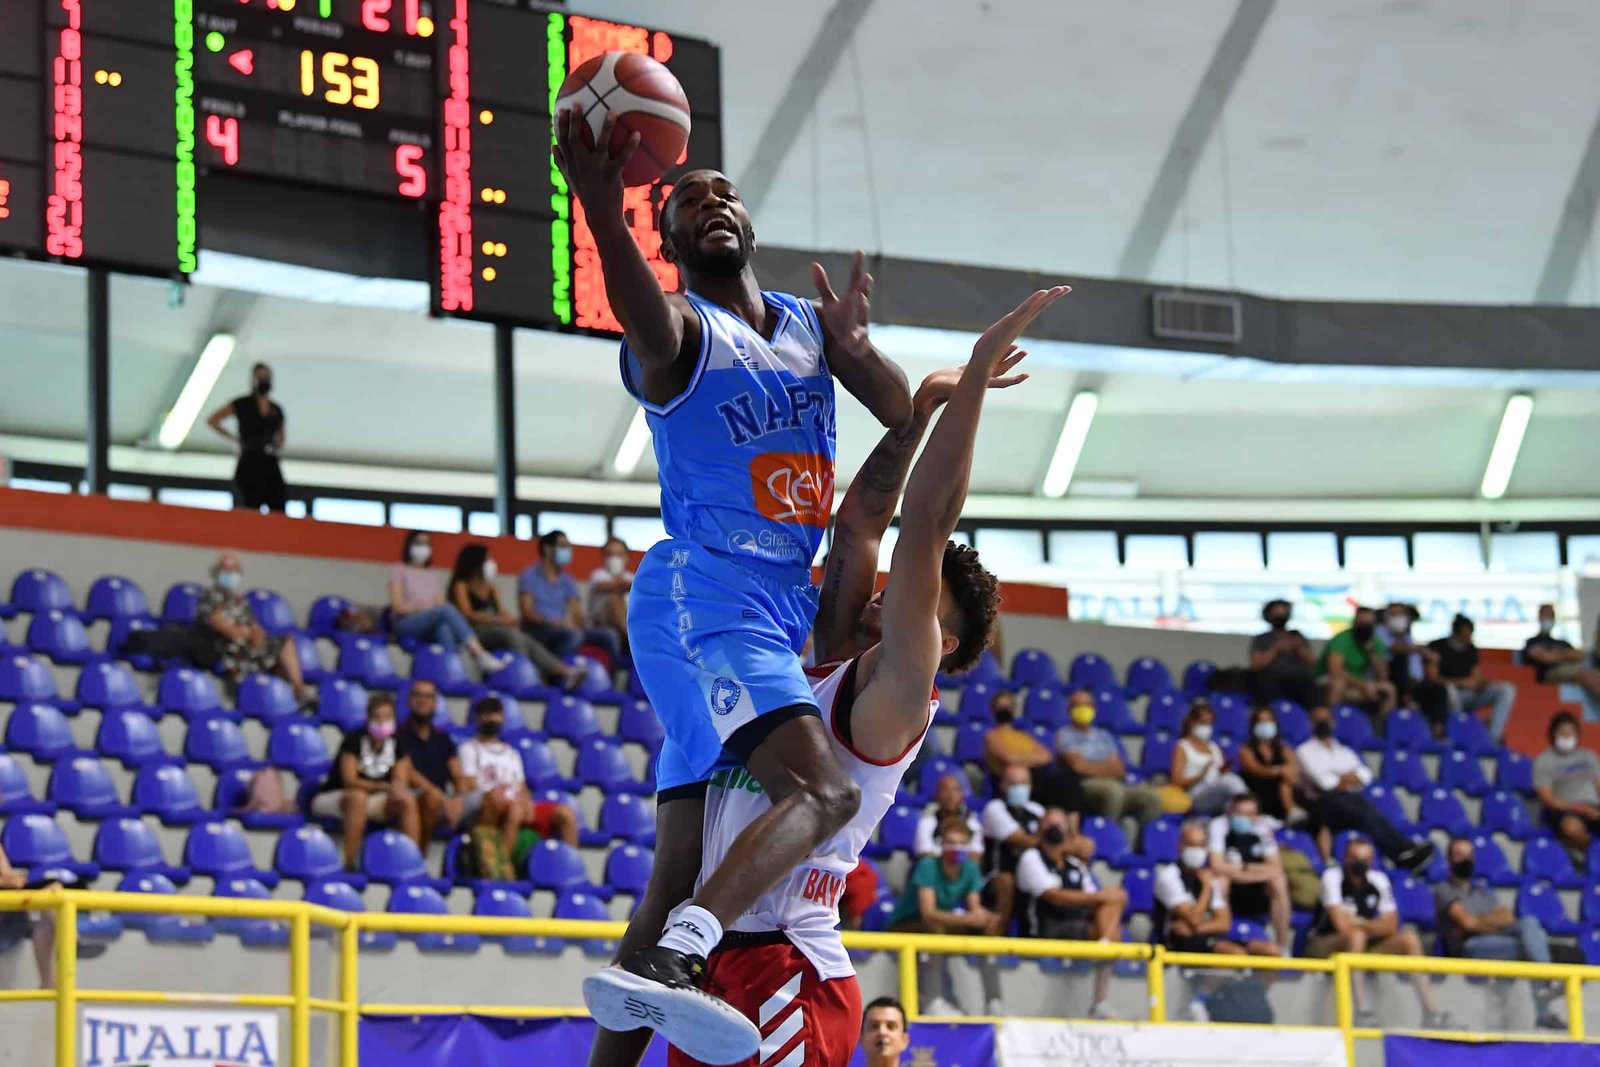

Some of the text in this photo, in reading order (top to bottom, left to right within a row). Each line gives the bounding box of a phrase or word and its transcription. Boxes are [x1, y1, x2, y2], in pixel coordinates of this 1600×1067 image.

[206, 115, 239, 166] 4
[395, 144, 427, 197] 5
[85, 1016, 275, 1067] ITALIA
